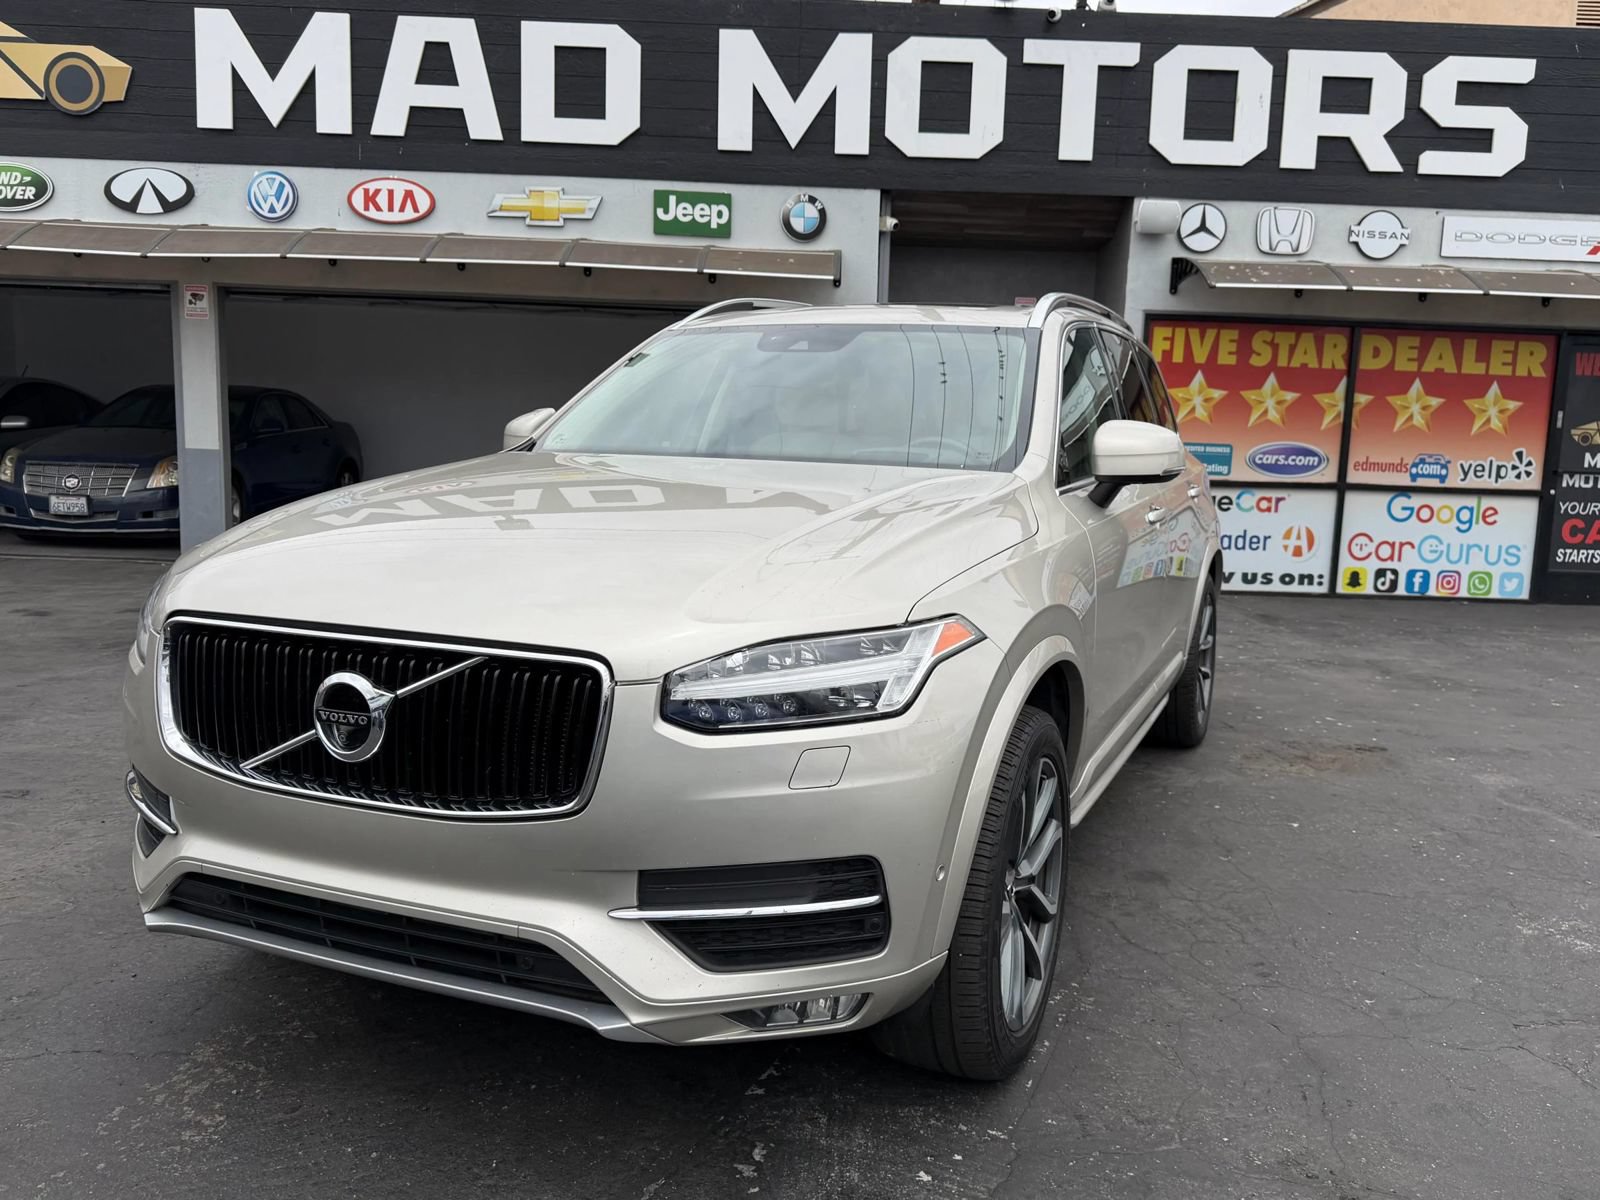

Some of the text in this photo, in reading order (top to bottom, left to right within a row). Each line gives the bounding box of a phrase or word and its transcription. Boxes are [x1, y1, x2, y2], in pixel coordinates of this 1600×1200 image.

[193, 7, 1537, 178] MAD MOTORS
[363, 187, 420, 214] KIA
[656, 194, 730, 229] Jeep
[786, 192, 824, 210] BMW
[1350, 229, 1410, 241] NISSAN
[1151, 326, 1548, 378] FIVE STAR DEALER
[1255, 453, 1319, 467] cars.com
[1353, 456, 1409, 474] edmunds
[1459, 458, 1508, 484] yelp
[1387, 492, 1499, 533] Google
[1560, 501, 1600, 516] YOUR
[1347, 532, 1522, 567] CarGurus
[1241, 572, 1274, 585] us
[1278, 572, 1324, 586] on:
[318, 710, 369, 725] VOLVO
